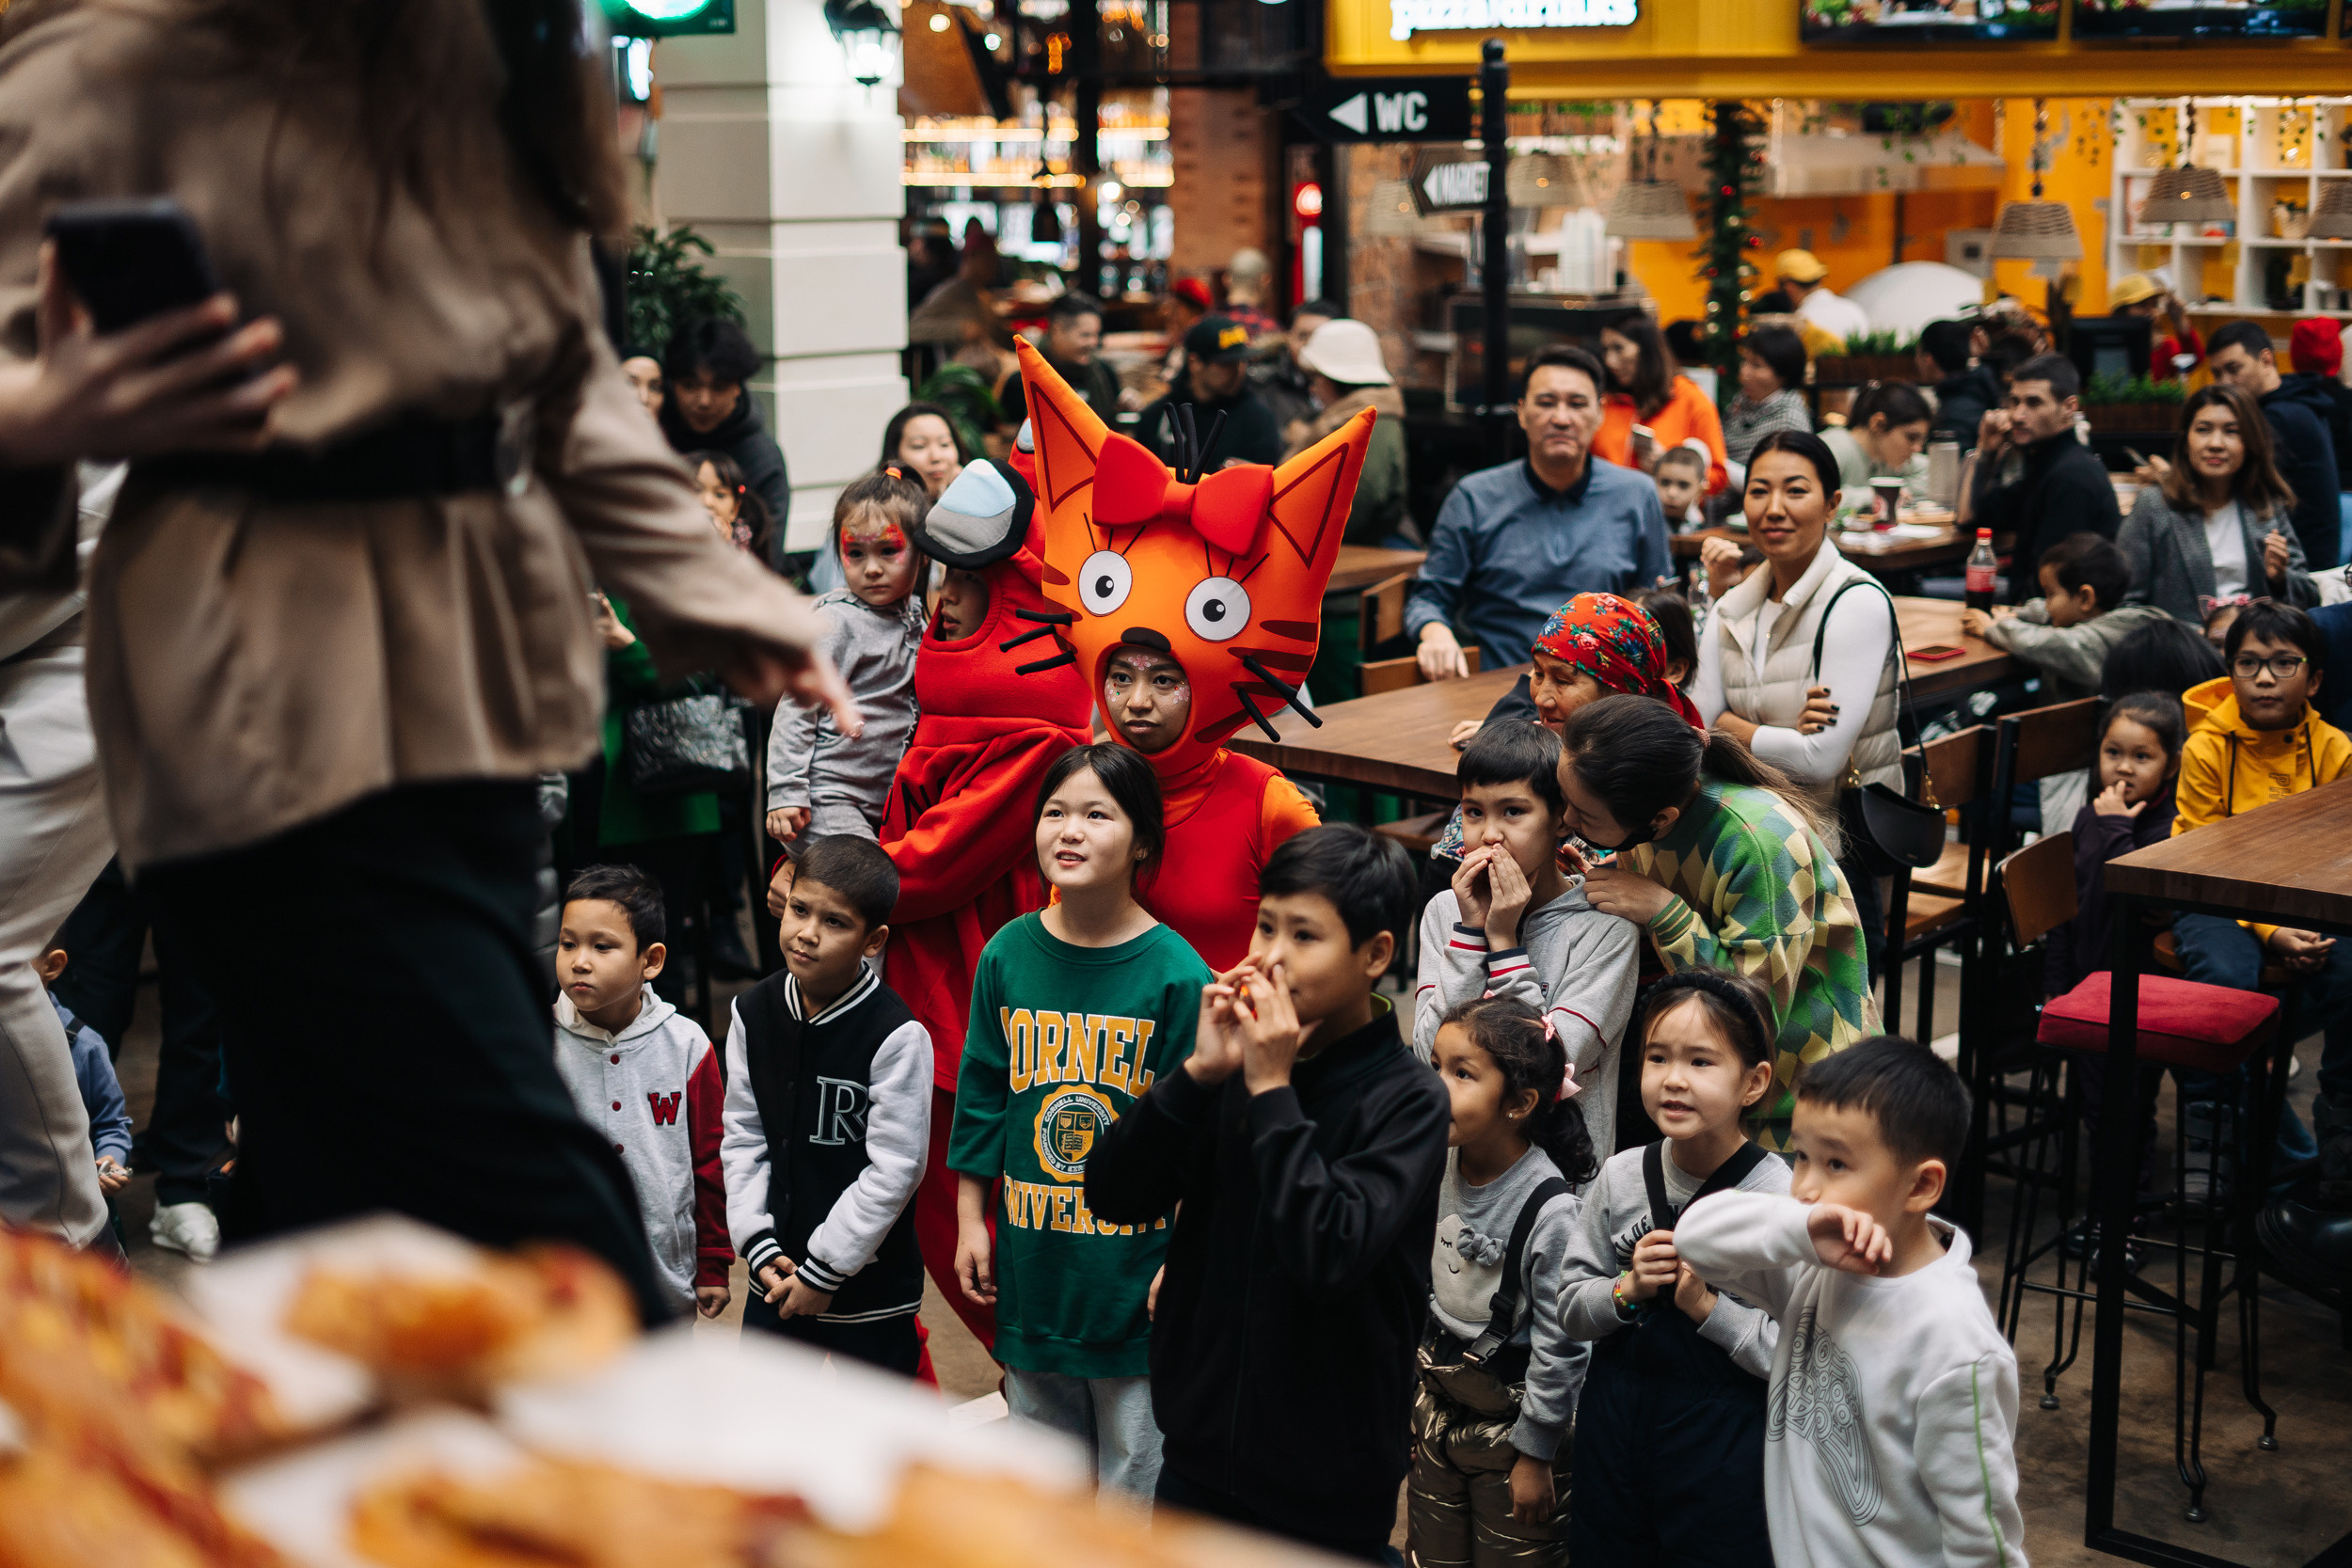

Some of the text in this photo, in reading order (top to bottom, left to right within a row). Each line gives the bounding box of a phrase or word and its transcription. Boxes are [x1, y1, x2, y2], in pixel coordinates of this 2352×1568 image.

[1374, 91, 1428, 132] WC
[647, 1091, 682, 1126] W
[809, 1075, 869, 1145] R
[1044, 1096, 1109, 1125] CORNELL UNIVERSITY
[1042, 1128, 1056, 1164] FOUNDED
[1055, 1162, 1066, 1170] BY
[1004, 1172, 1167, 1236] NIVER
